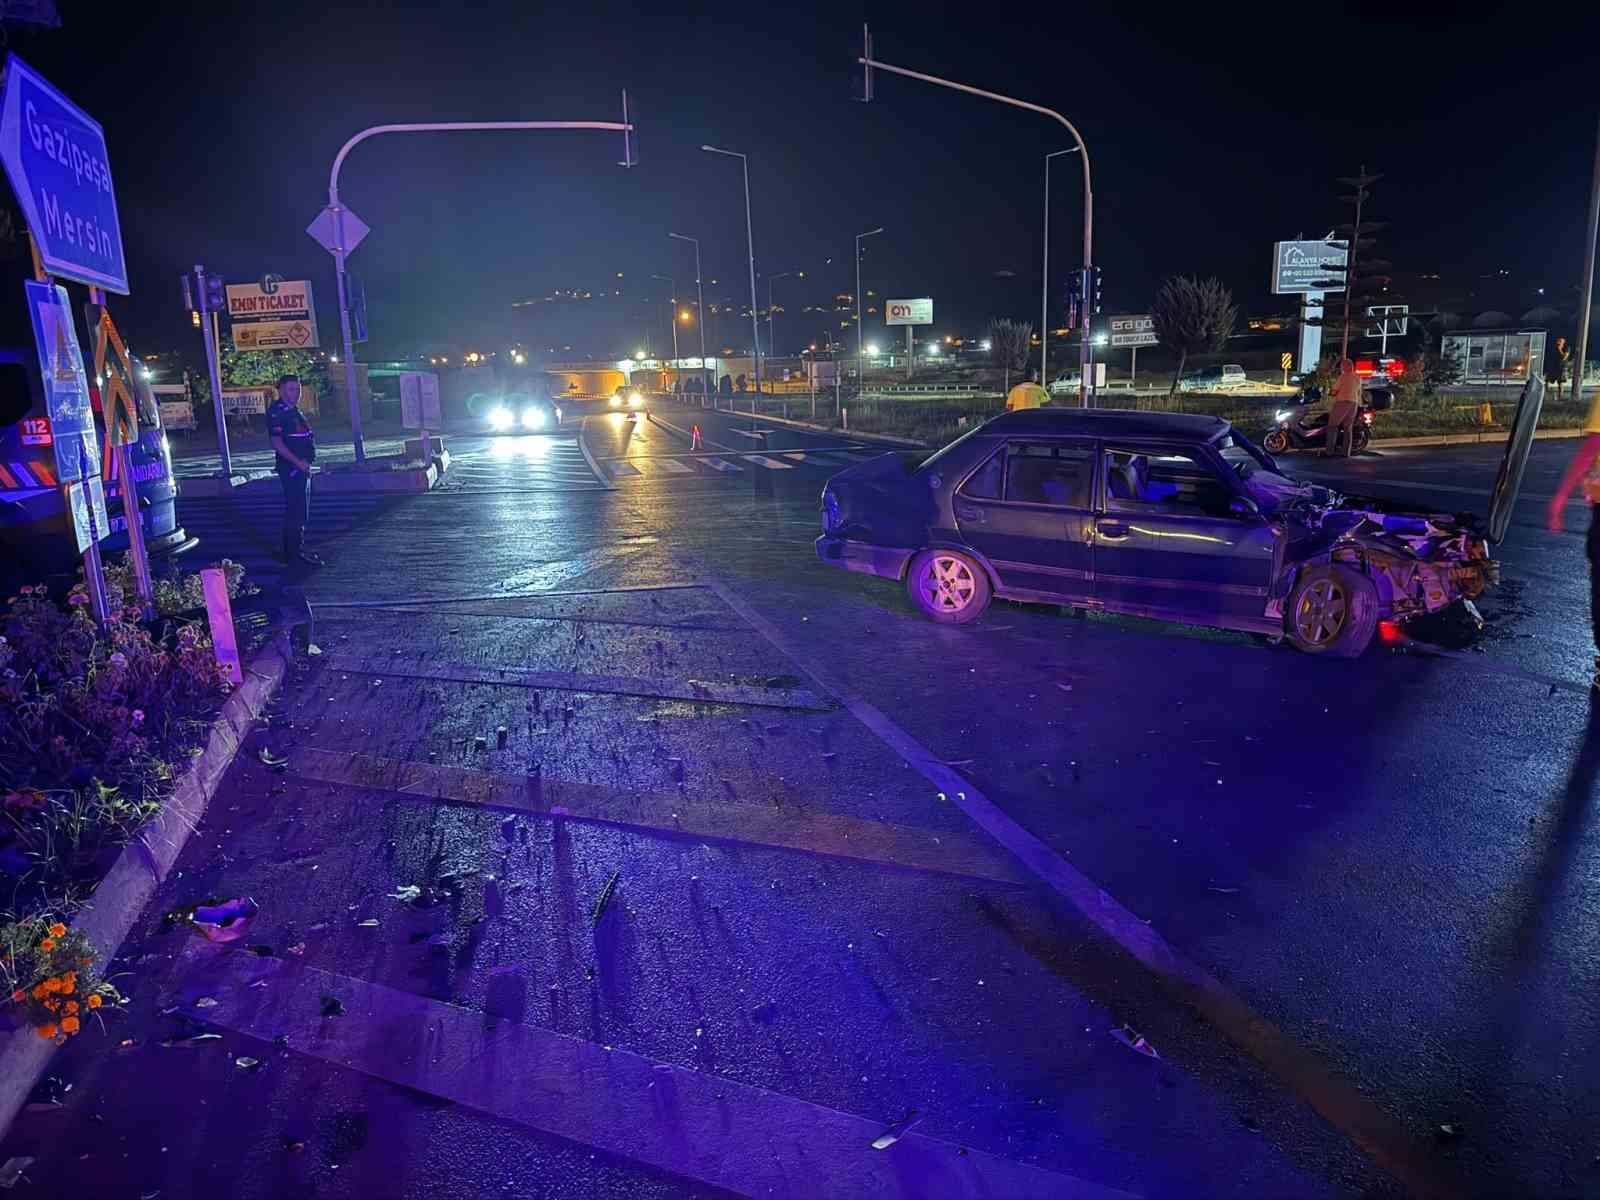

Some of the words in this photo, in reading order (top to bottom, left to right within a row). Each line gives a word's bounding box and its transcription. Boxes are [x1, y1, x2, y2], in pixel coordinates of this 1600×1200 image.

[25, 100, 110, 193] Gazipaşa
[41, 188, 113, 260] Mersin
[24, 420, 47, 434] 112
